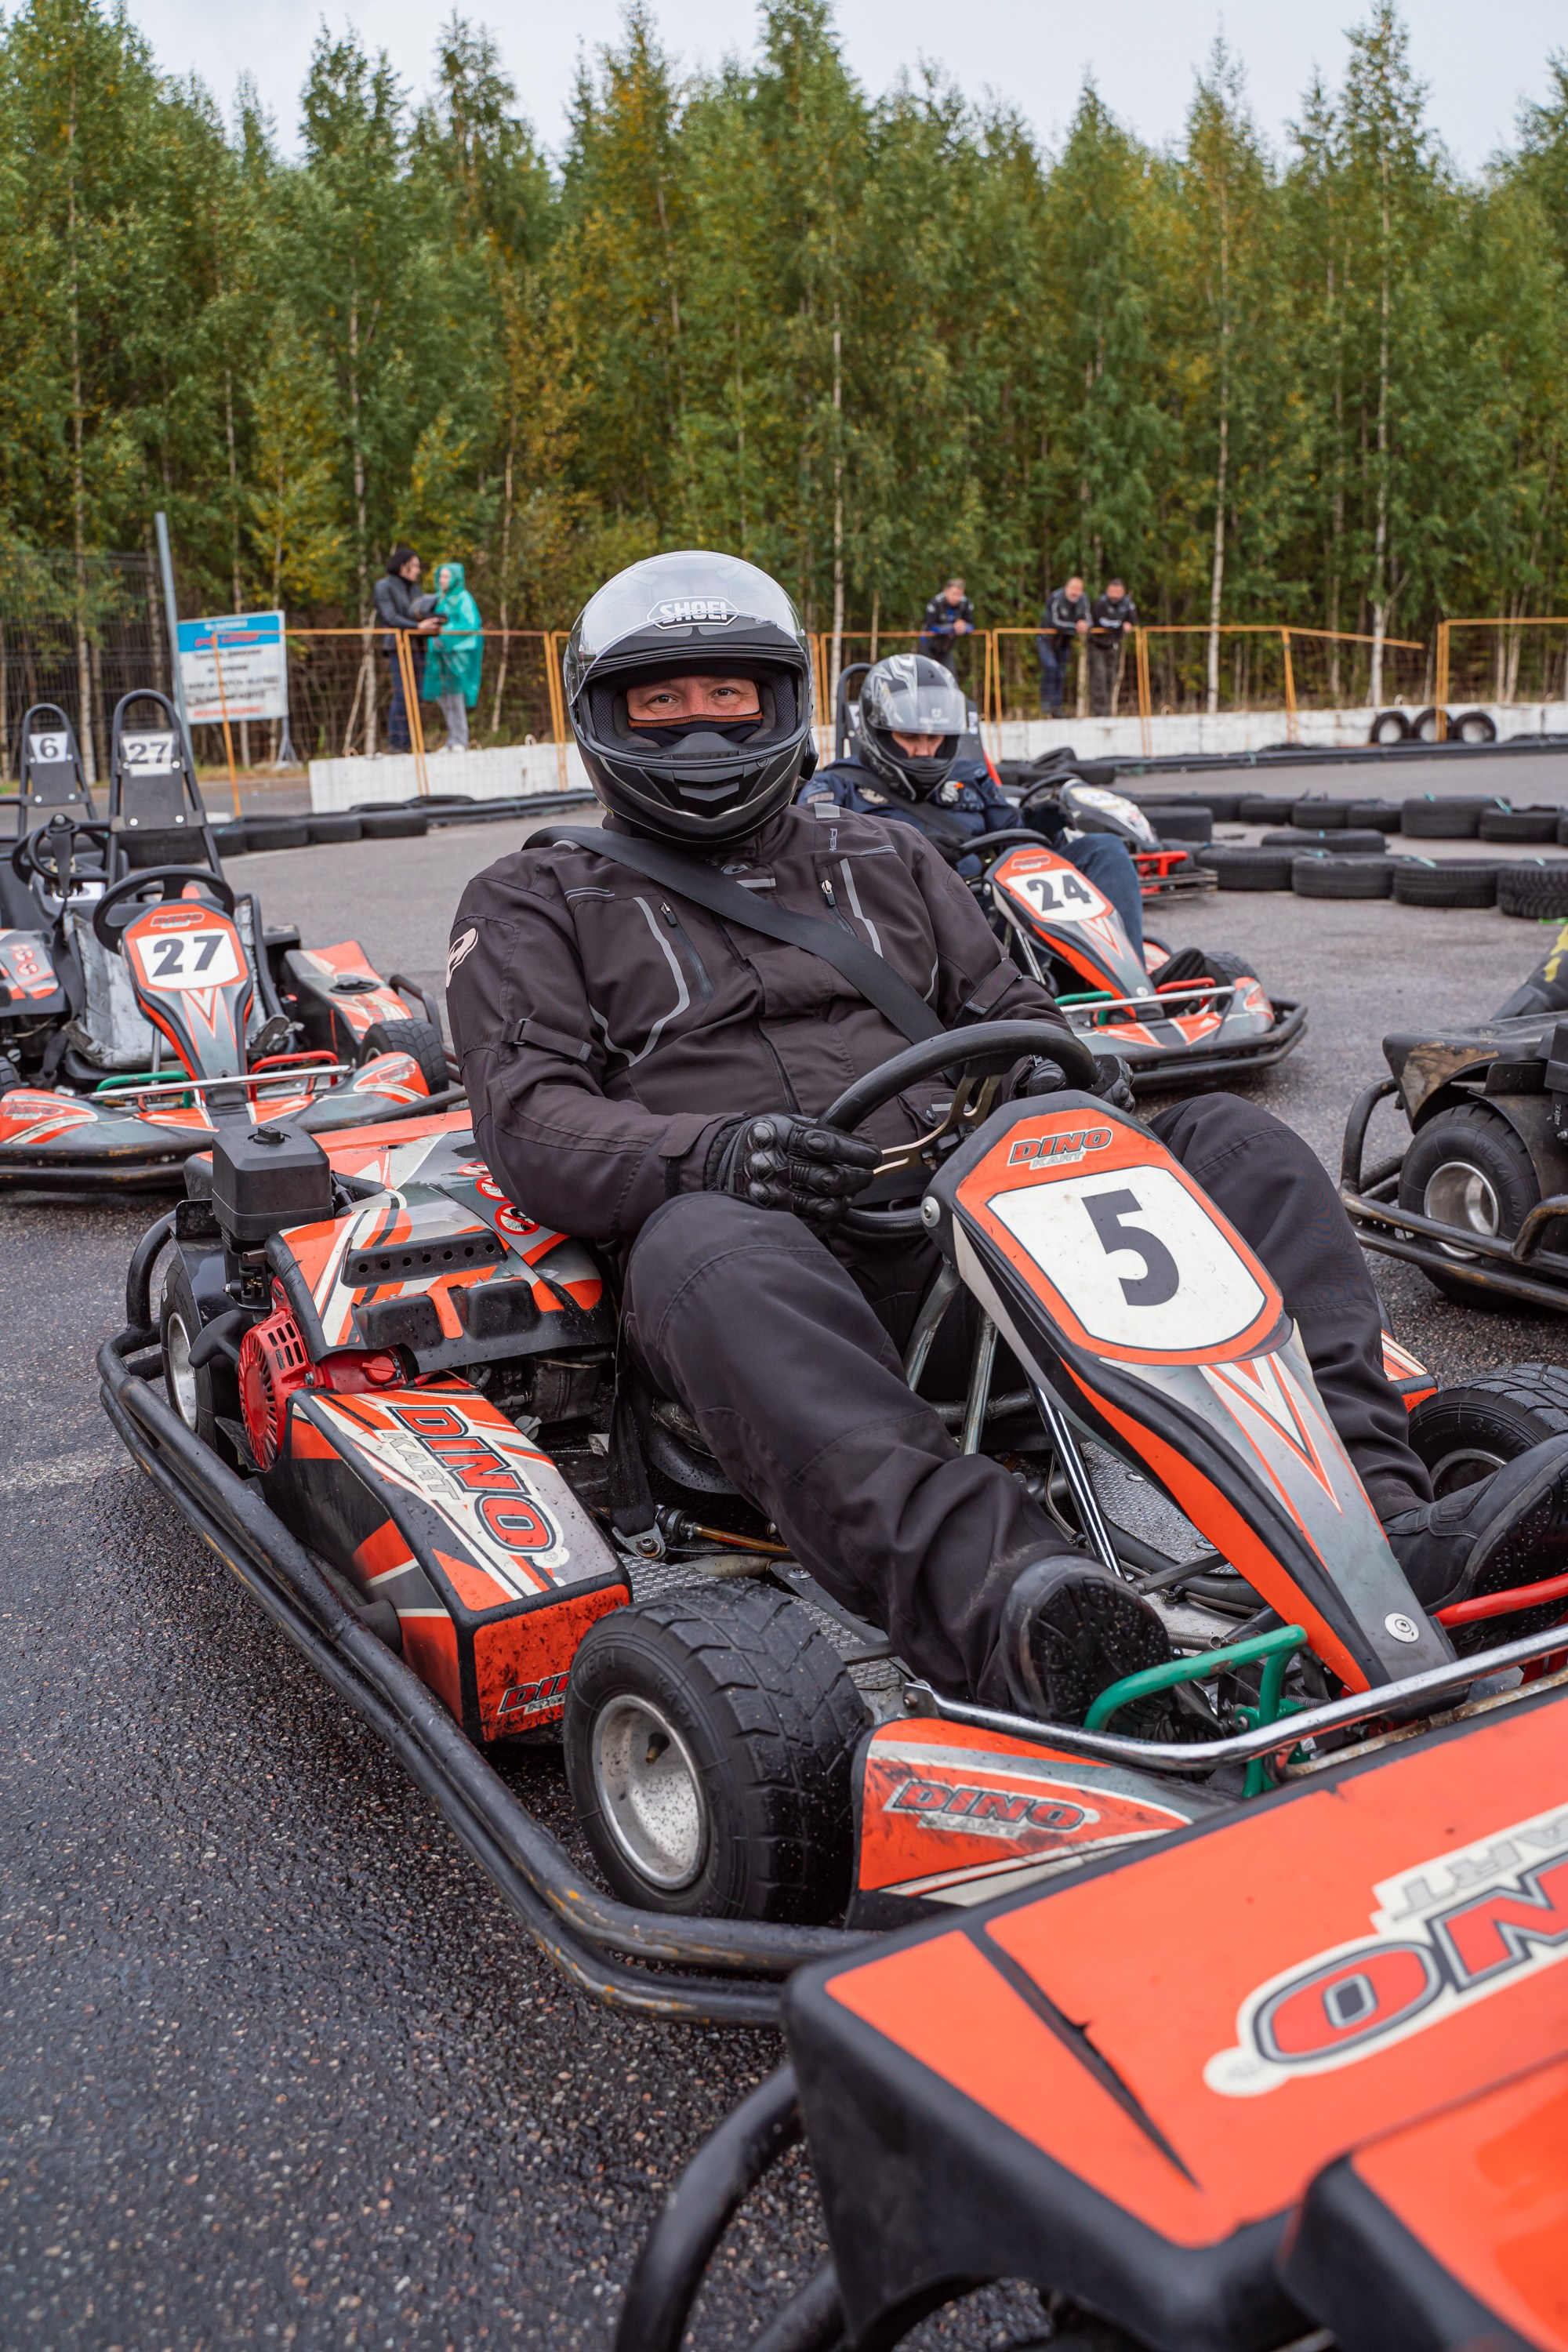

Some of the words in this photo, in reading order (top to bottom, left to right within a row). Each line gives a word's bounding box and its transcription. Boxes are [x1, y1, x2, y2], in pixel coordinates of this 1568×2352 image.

[659, 601, 728, 624] SHOEI
[39, 737, 58, 759] 6
[128, 741, 169, 765] 27
[1025, 874, 1092, 912] 24
[152, 935, 224, 978] 27
[1008, 1128, 1112, 1164] DINO
[1032, 1150, 1084, 1168] KART
[1080, 1188, 1180, 1307] 5
[381, 1432, 461, 1501] KART
[384, 1405, 557, 1553] DINO
[499, 1671, 571, 1713] DI
[891, 1780, 1085, 1831] DINO
[1392, 1812, 1568, 1922] ART
[1251, 1848, 1568, 2065] NO
